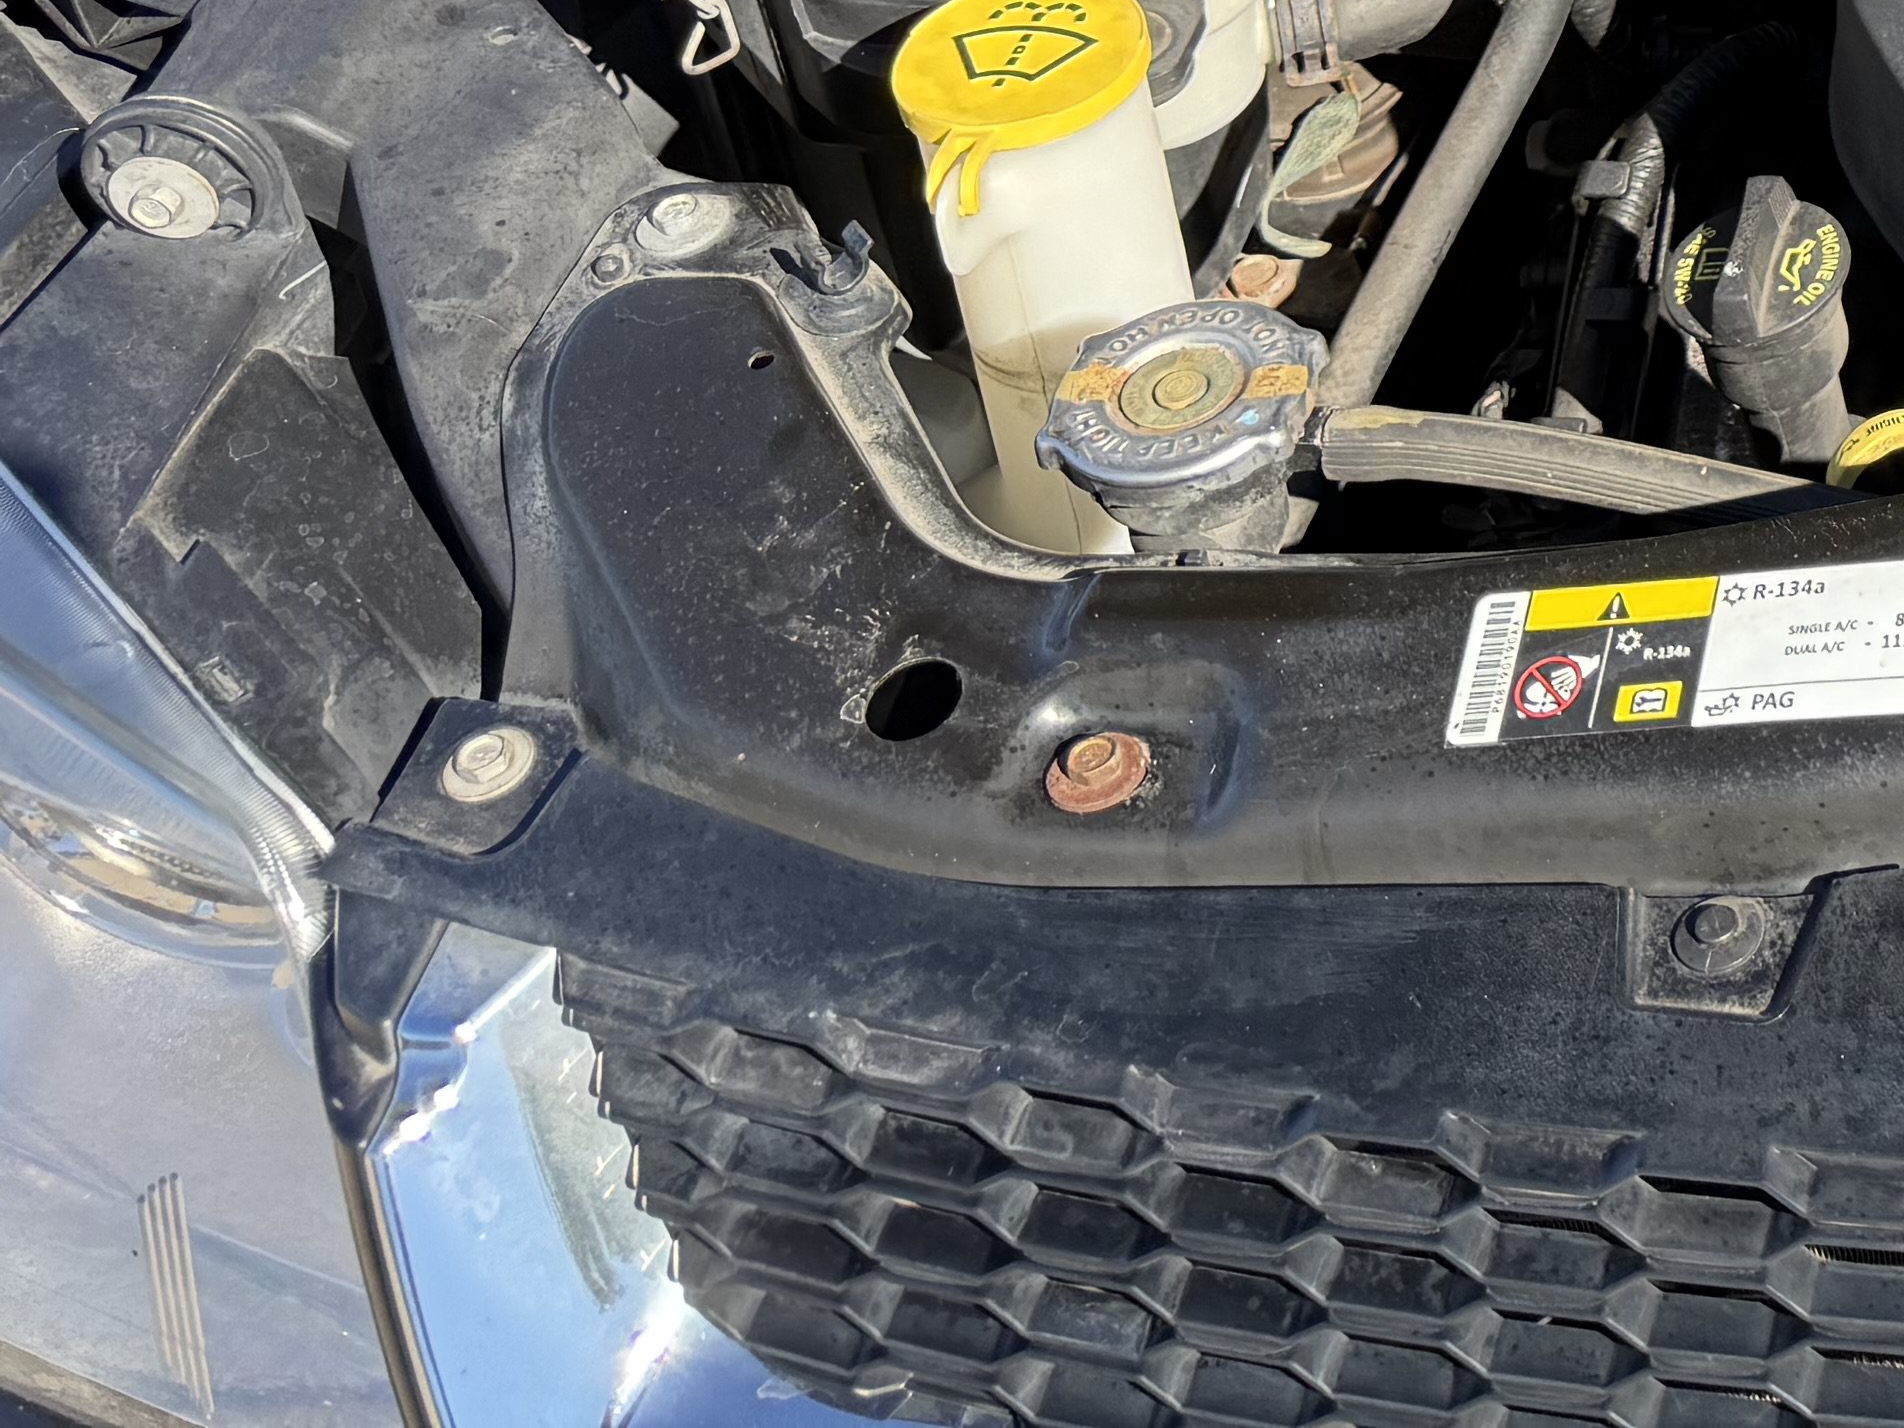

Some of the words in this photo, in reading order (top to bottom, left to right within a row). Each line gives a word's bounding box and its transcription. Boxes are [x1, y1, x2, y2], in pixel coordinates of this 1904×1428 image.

[1815, 223, 1842, 282] ENGINE
[1792, 281, 1826, 307] OIL
[1157, 307, 1243, 332] OPEN
[1752, 578, 1826, 601] R-134a
[1787, 621, 1832, 636] SINGLE
[1834, 618, 1859, 633] A/C
[1642, 645, 1692, 661] R-134a
[1784, 644, 1818, 656] DUAL
[1821, 640, 1846, 654] A/C
[1750, 690, 1796, 711] PAG
